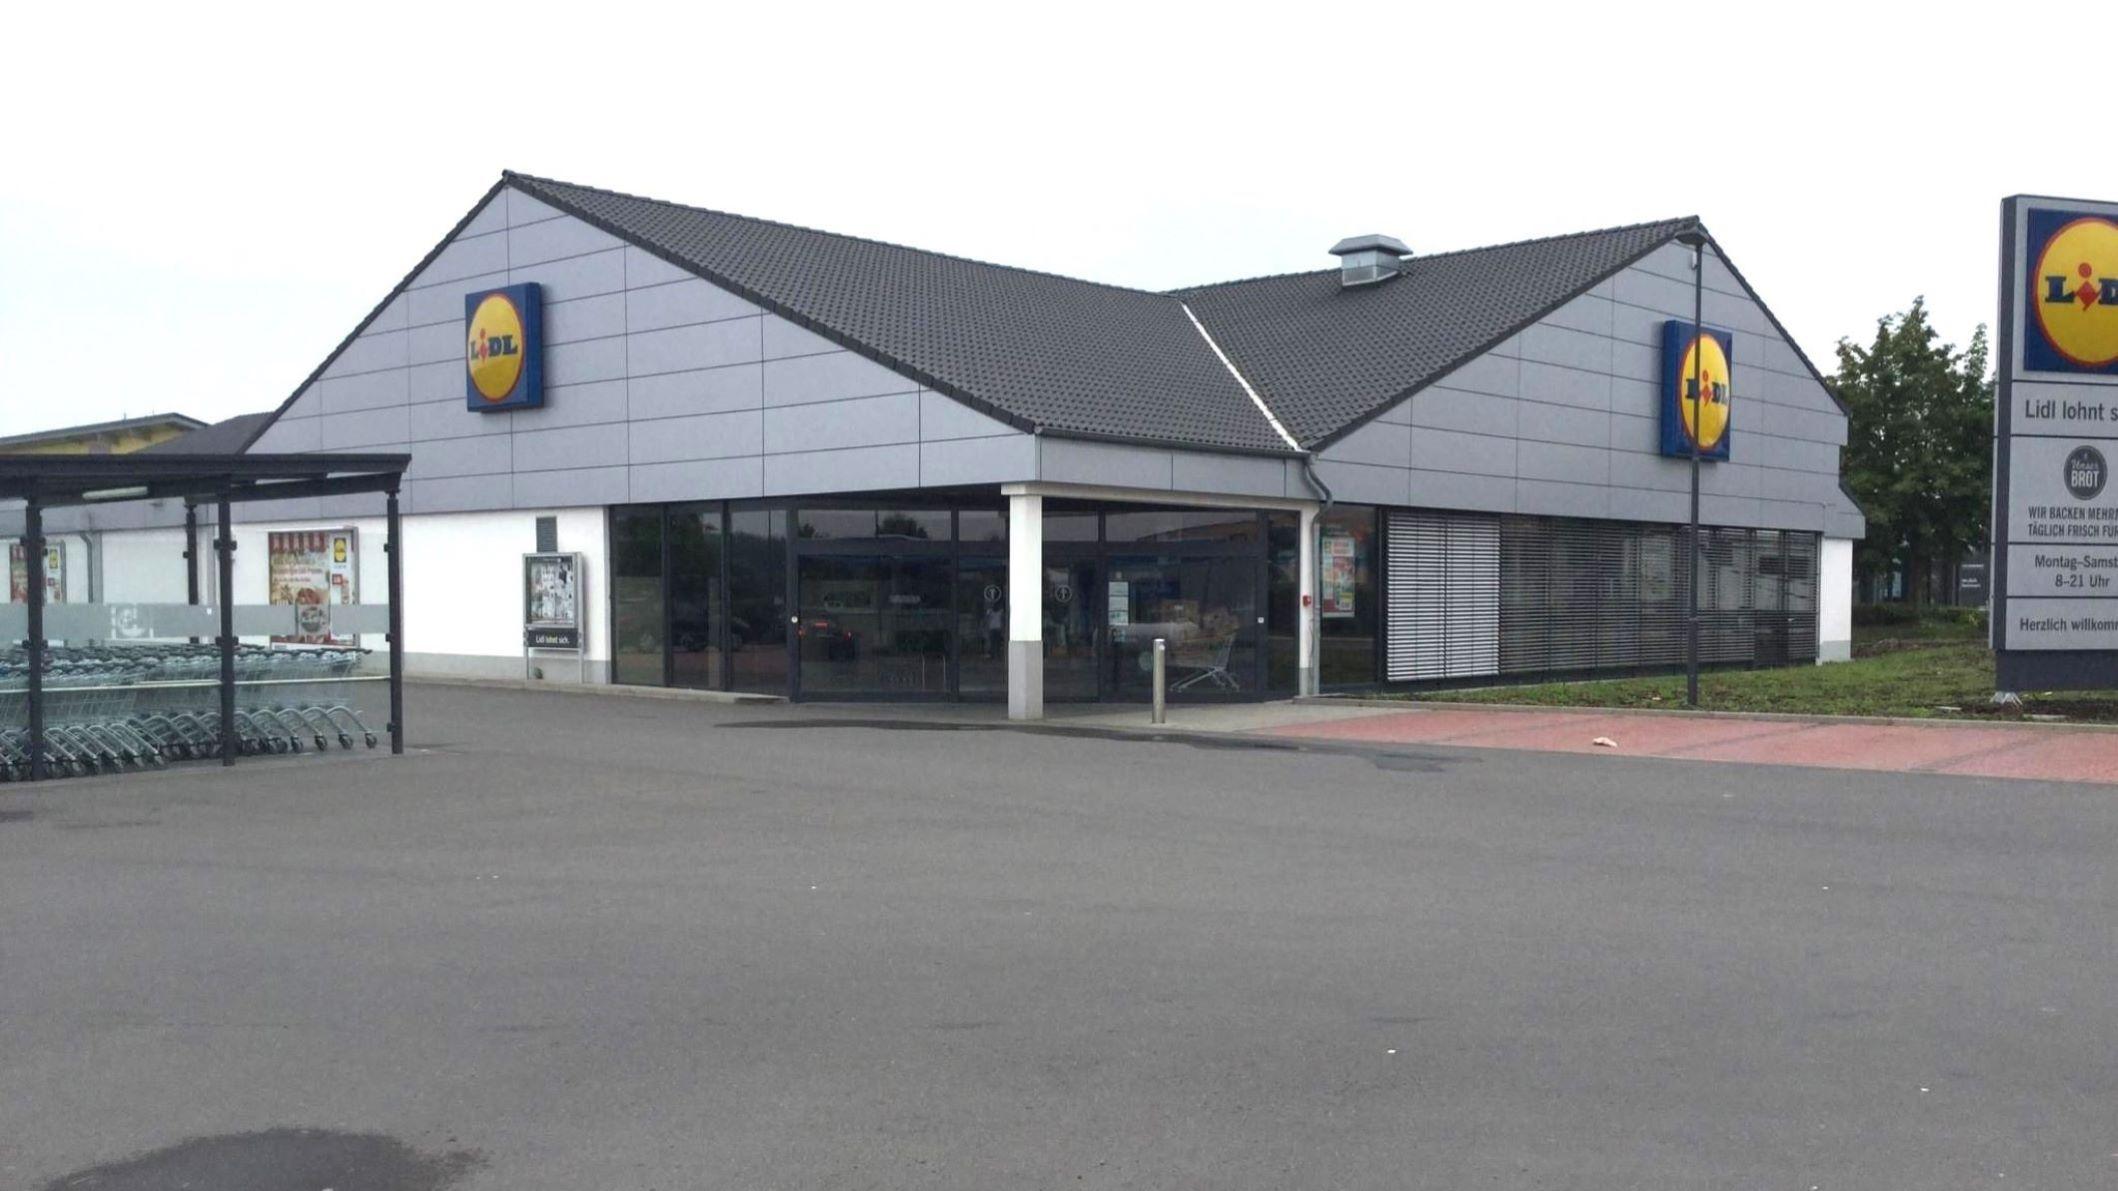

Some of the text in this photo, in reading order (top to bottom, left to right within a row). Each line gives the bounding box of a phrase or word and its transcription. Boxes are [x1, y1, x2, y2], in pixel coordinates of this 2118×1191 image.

[2025, 399, 2056, 419] Lidl
[2062, 400, 2105, 421] lohnt
[2071, 470, 2100, 488] BROT
[2028, 506, 2047, 519] WIR
[2049, 507, 2086, 520] BACKEN
[2028, 521, 2065, 537] TÄGLICH
[2067, 524, 2100, 537] FRISCH
[2089, 574, 2110, 588] Uhr
[2019, 617, 2067, 632] Herzlich
